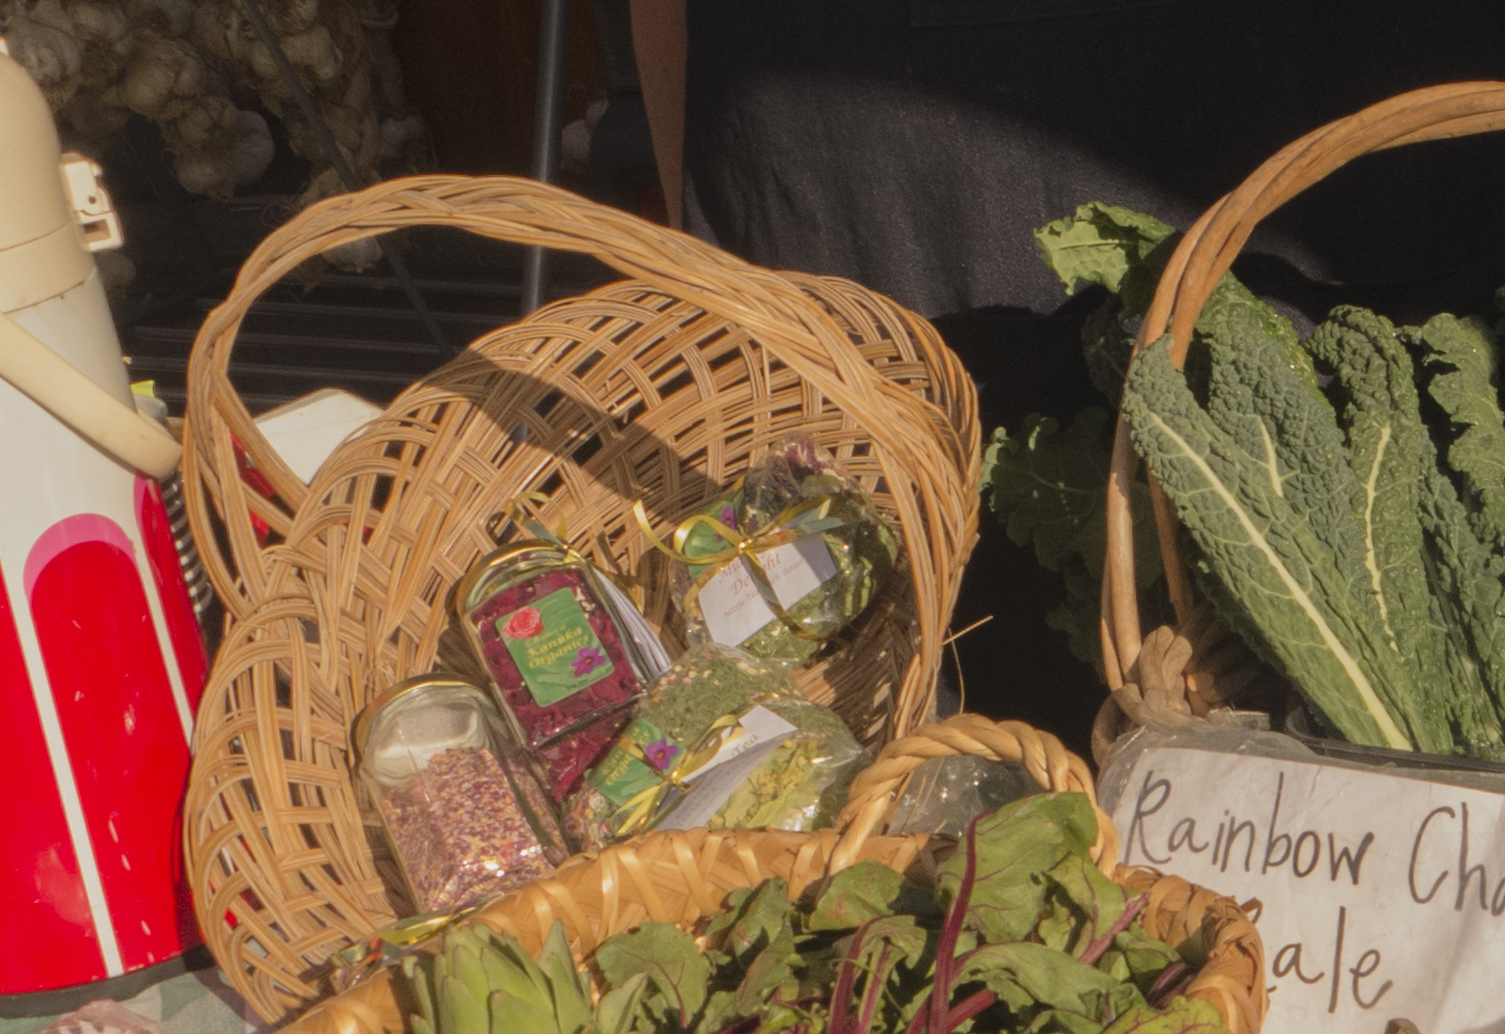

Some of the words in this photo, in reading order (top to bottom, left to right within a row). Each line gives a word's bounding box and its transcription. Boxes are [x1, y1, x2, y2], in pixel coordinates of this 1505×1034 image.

[527, 626, 582, 657] Kanuka
[529, 635, 588, 668] Organics
[1123, 768, 1376, 887] Rainbow
